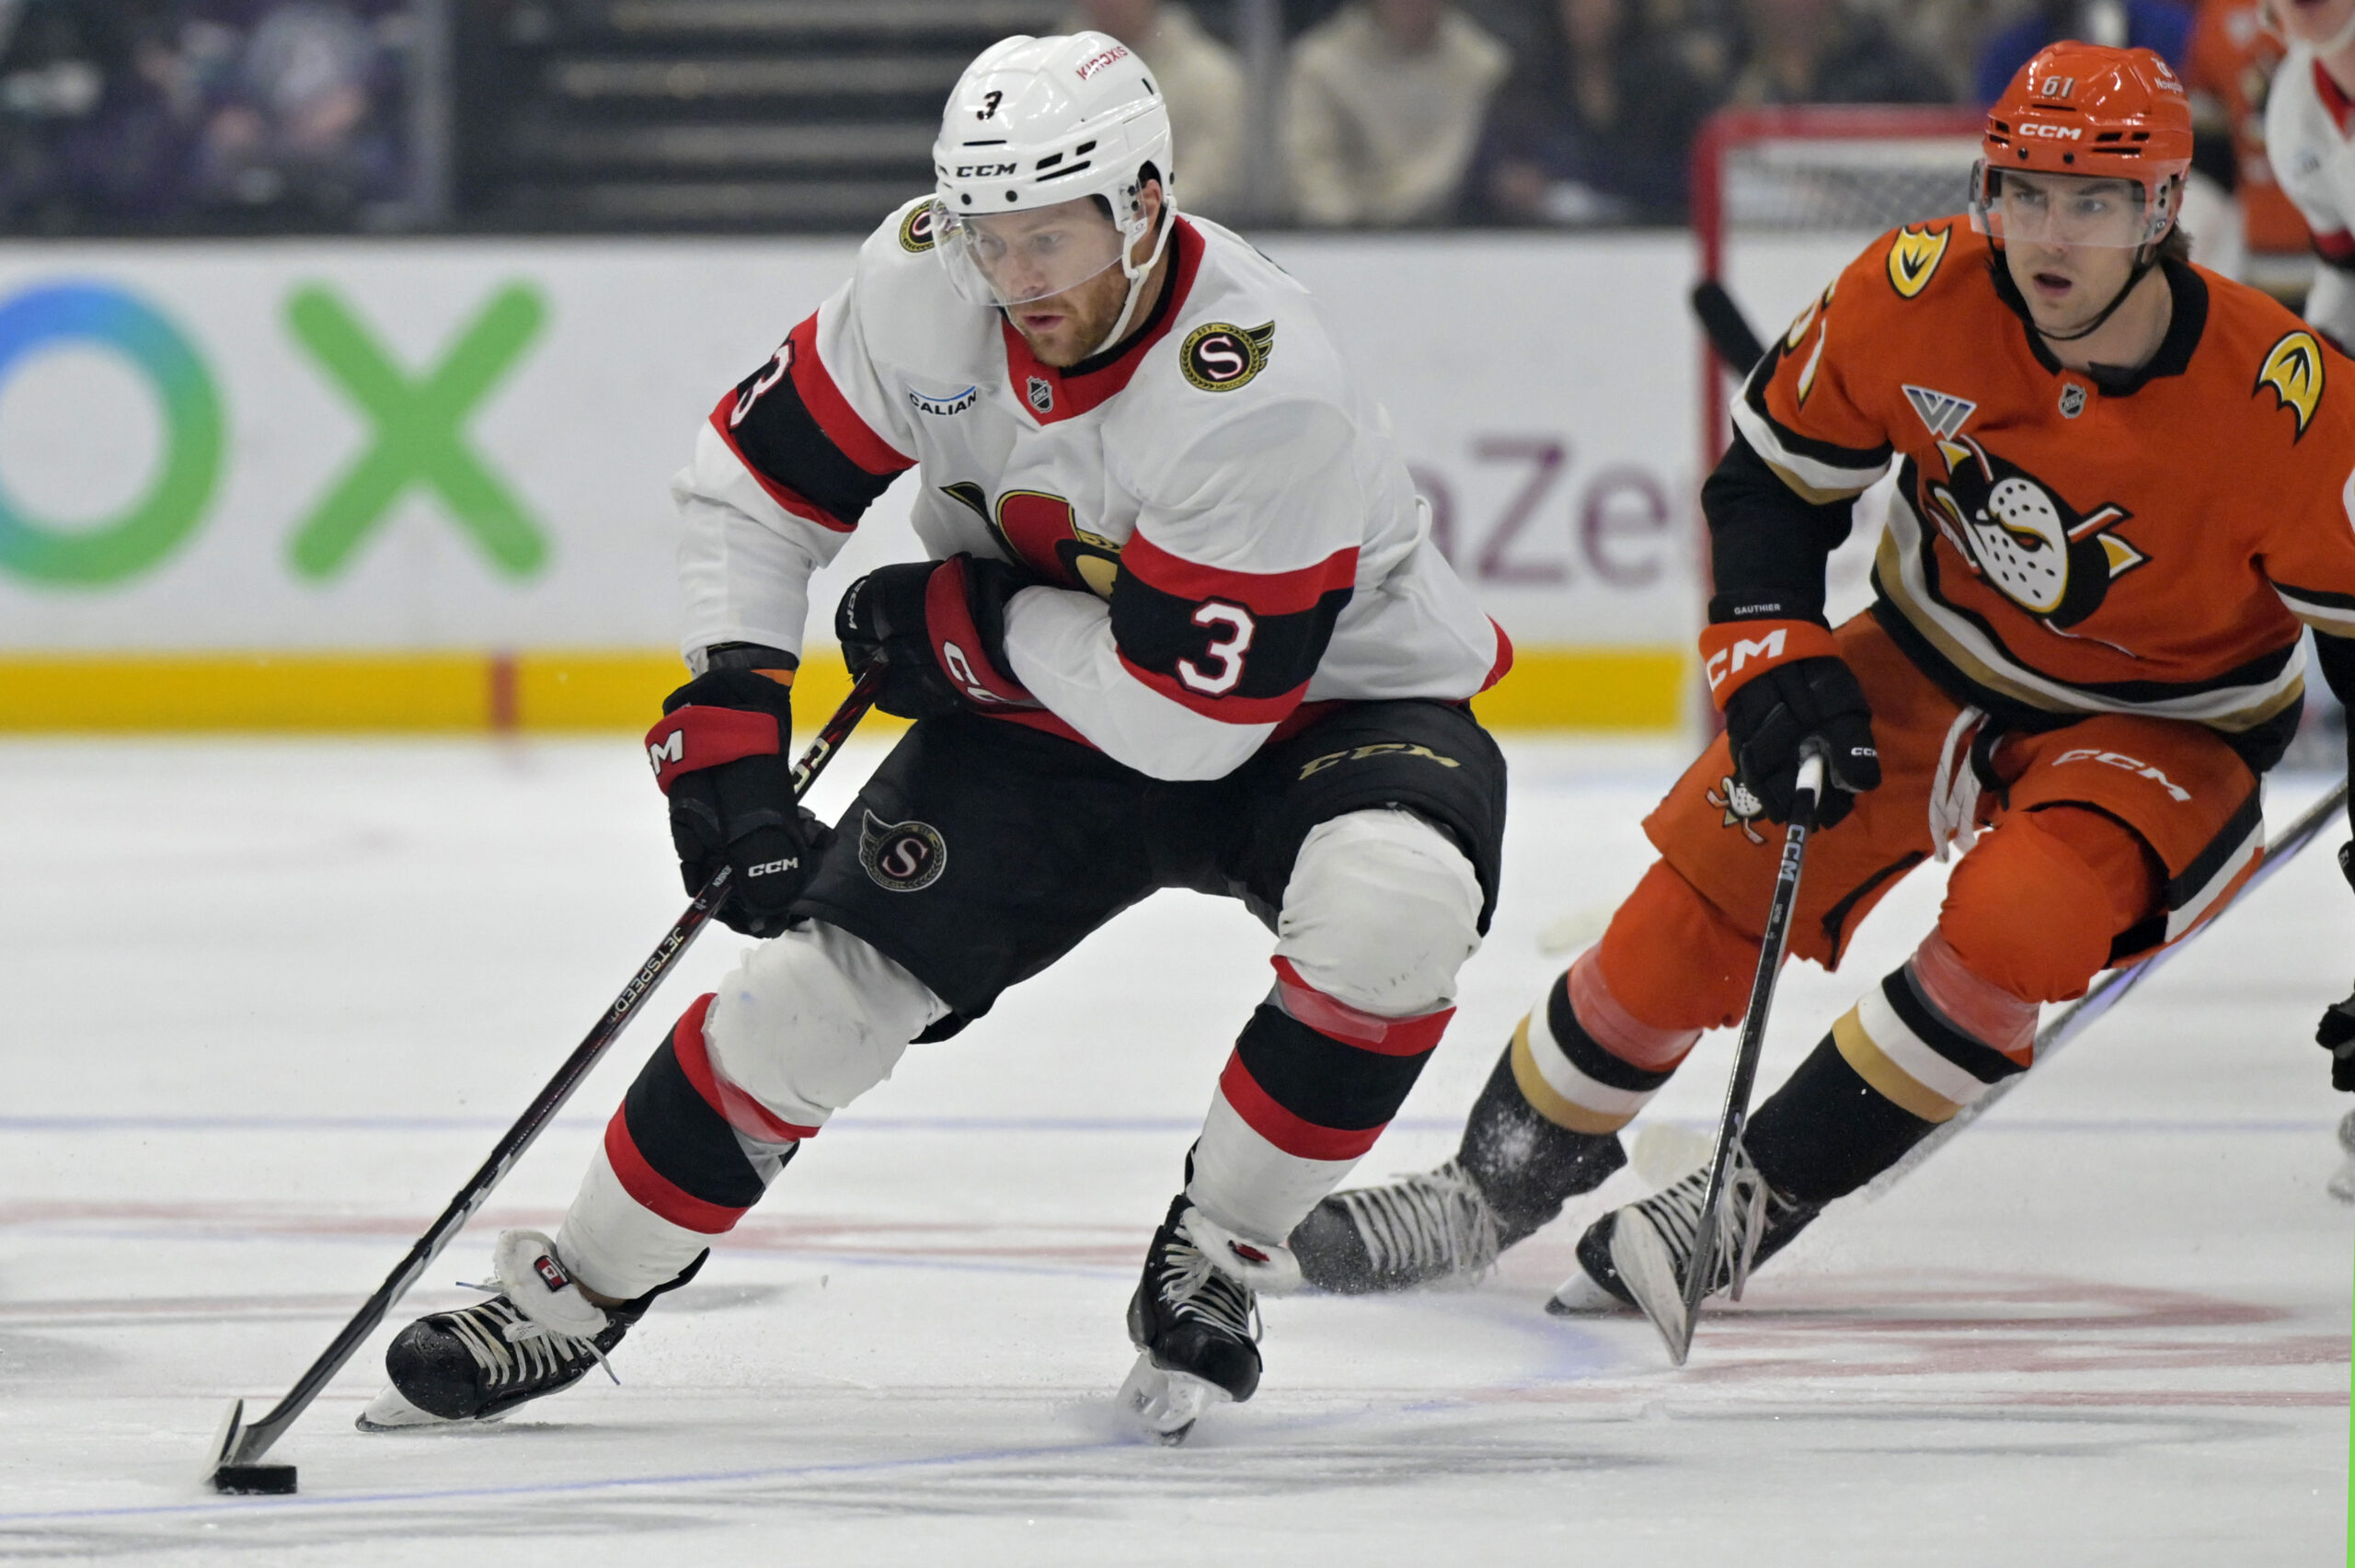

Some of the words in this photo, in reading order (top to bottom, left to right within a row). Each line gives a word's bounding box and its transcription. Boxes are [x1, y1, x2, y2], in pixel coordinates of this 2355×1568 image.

[2041, 75, 2075, 98] 61
[977, 90, 1004, 120] 3
[2018, 123, 2083, 141] CCM
[957, 163, 1017, 177] CCM
[729, 342, 793, 429] 3
[908, 390, 978, 416] CALIAN
[1733, 603, 1781, 615] GAUTHIER
[1177, 600, 1256, 698] 3
[1706, 628, 1788, 693] CM
[1298, 742, 1462, 781] CCM
[2051, 749, 2192, 802] CCM
[748, 857, 798, 878] CCM
[1778, 823, 1806, 882] CCM
[614, 926, 684, 1010] JETSPEED
